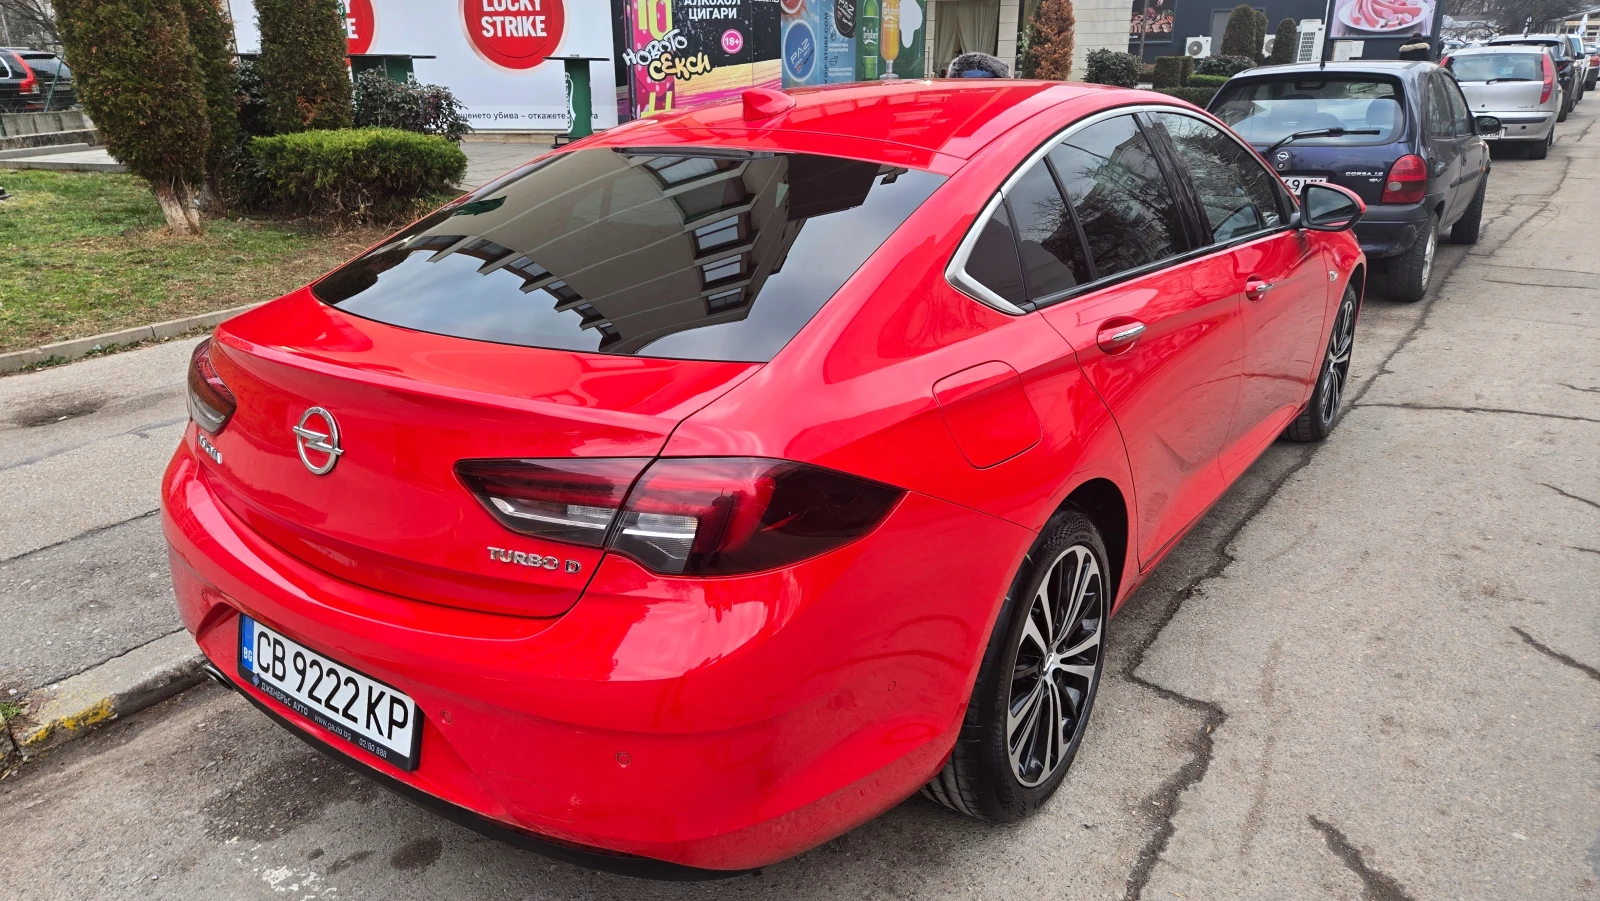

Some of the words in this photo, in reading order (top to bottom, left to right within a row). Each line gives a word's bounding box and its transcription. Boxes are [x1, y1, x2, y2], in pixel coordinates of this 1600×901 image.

[688, 7, 737, 21] ЦИГАРИ
[481, 15, 548, 37] STRIKE
[725, 37, 740, 46] 18+
[790, 37, 810, 65] PAZ
[649, 52, 712, 80] СЕКСИ
[493, 111, 519, 121] убива
[487, 546, 560, 570] TURBO
[564, 559, 582, 573] D
[243, 646, 253, 663] BG
[293, 651, 360, 724] 9222
[292, 701, 309, 716] АУТО
[314, 715, 352, 742] www.gauto.bg
